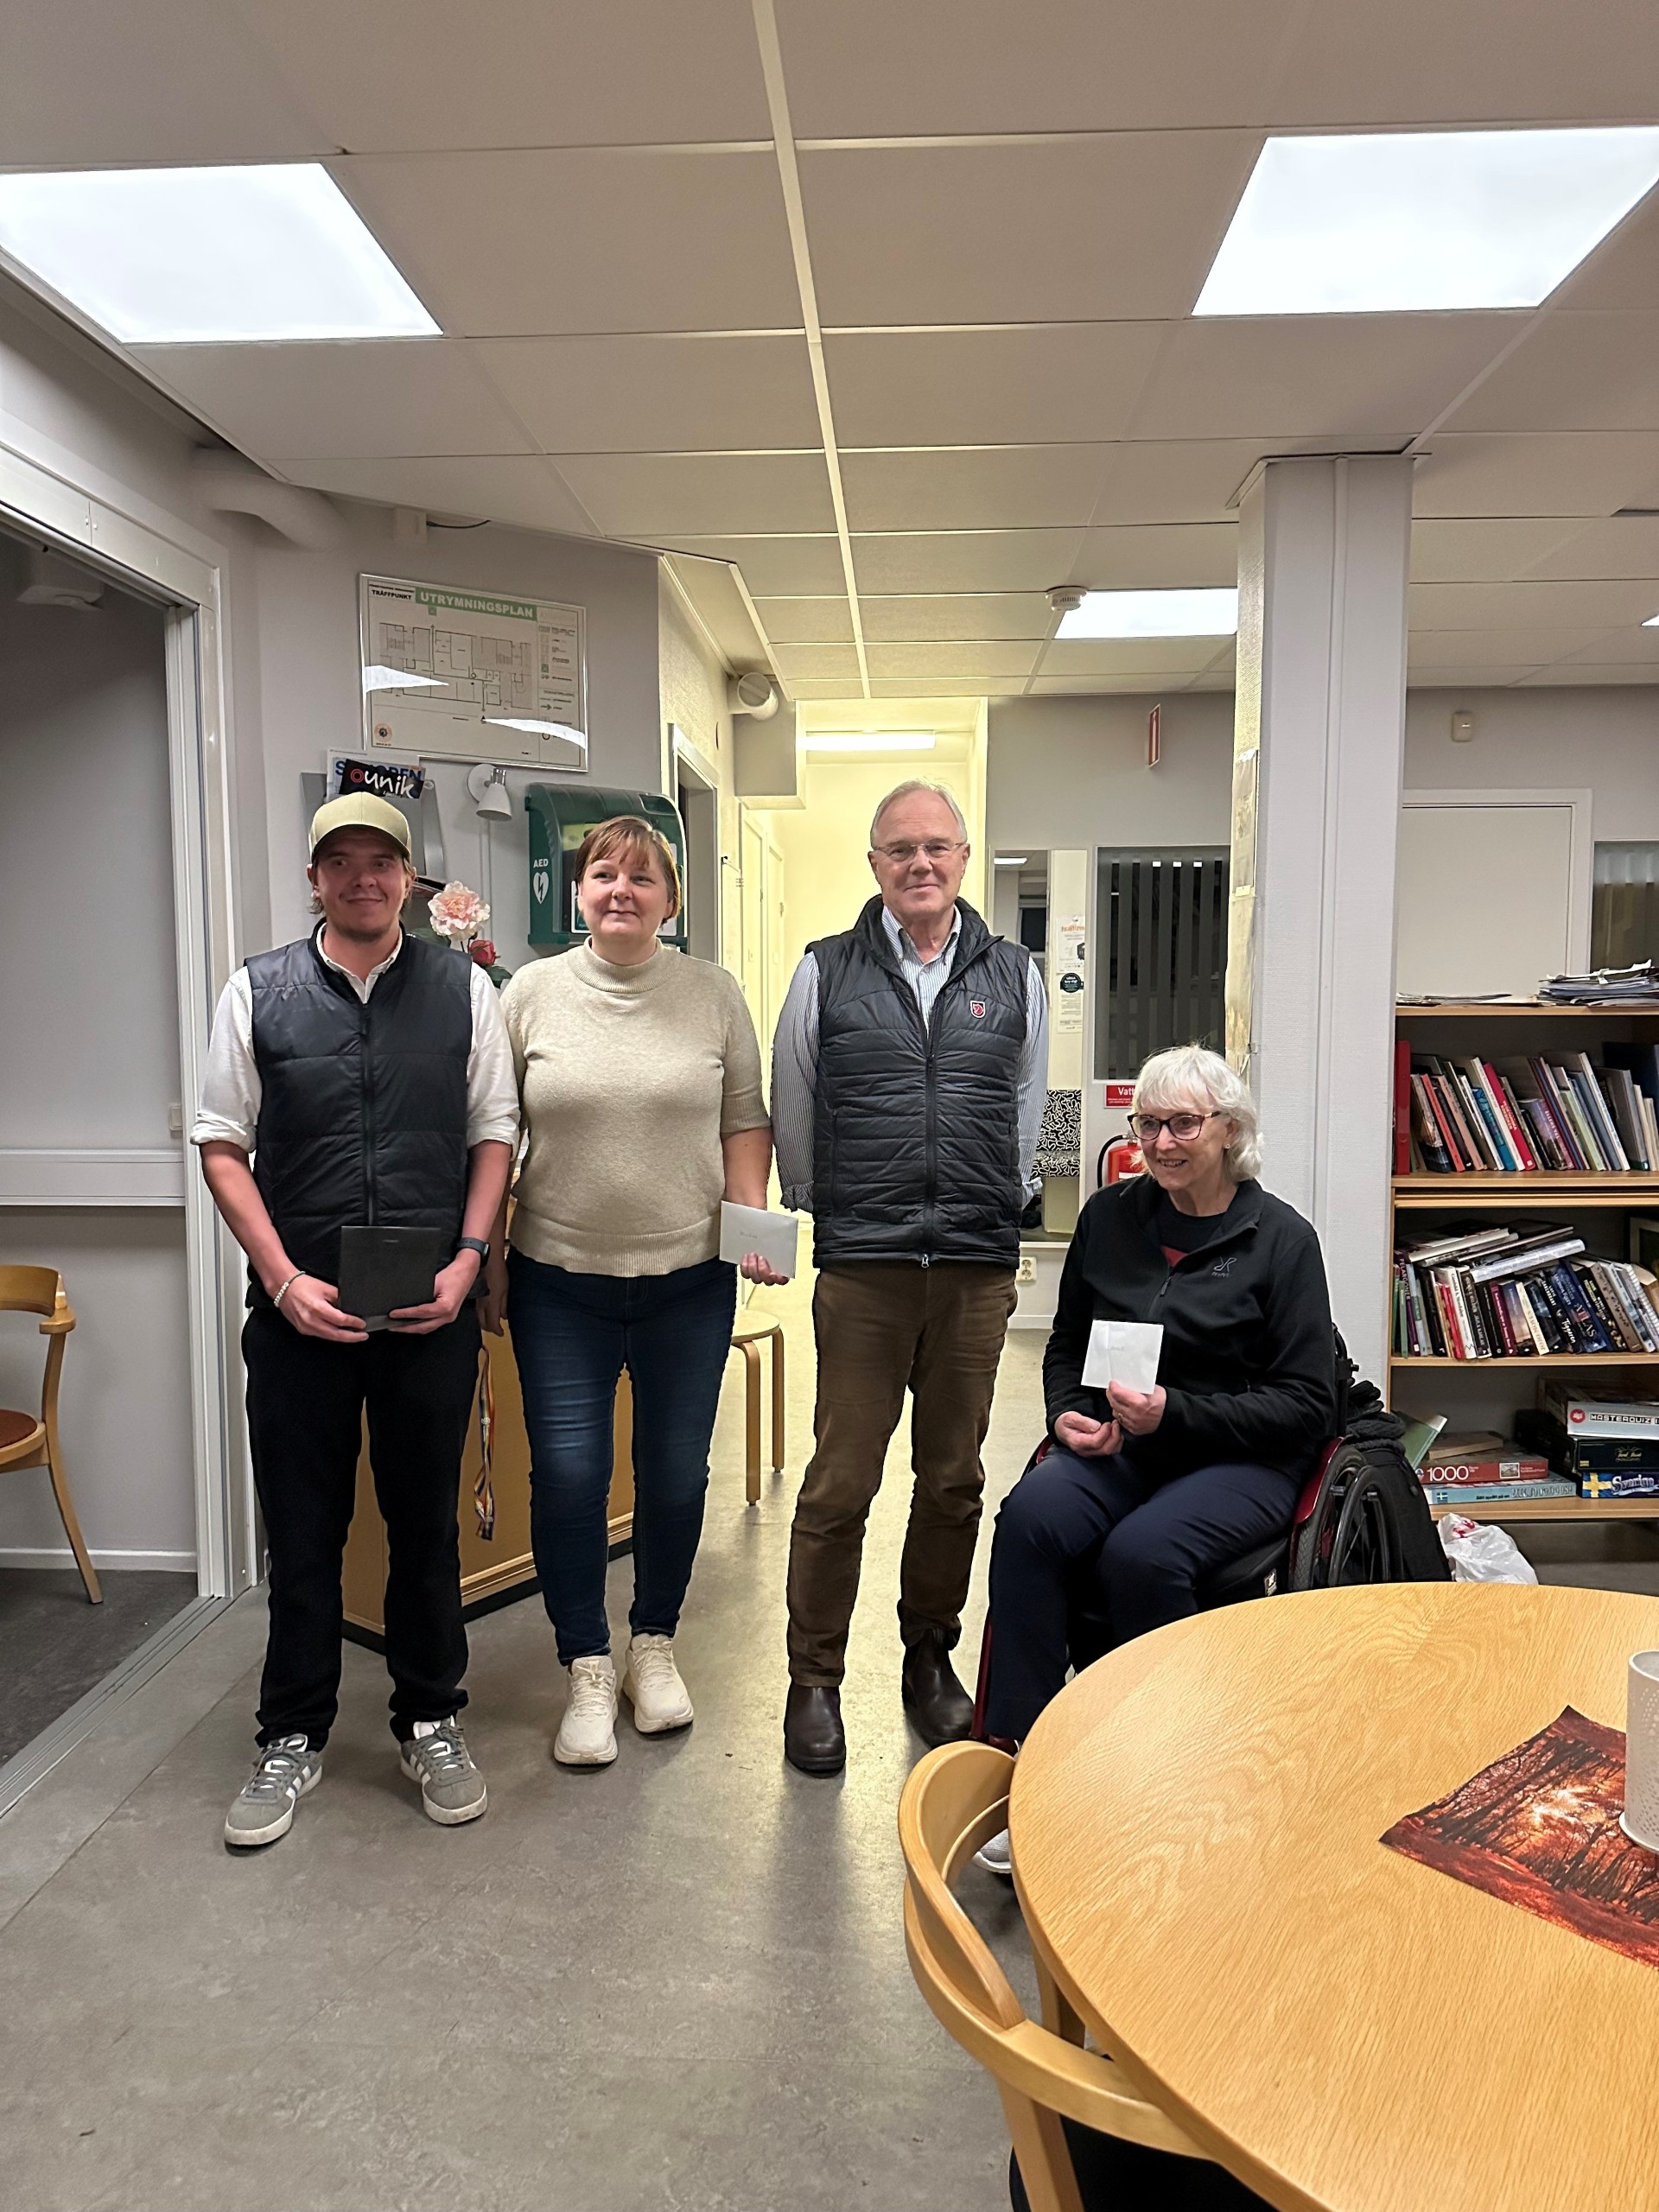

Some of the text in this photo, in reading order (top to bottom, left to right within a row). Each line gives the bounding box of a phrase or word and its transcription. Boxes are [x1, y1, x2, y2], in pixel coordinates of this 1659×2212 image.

[420, 592, 533, 618] UTRYMNINGSPLAN
[533, 858, 549, 868] AED
[1399, 1258, 1410, 1300] PELARGONER
[1573, 1300, 1597, 1338] ATLAS
[1559, 1318, 1579, 1344] Tiggaren
[1591, 1414, 1651, 1423] MASTERQUIZ
[1427, 1465, 1468, 1481] 1000
[1612, 1474, 1655, 1491] Sverige
